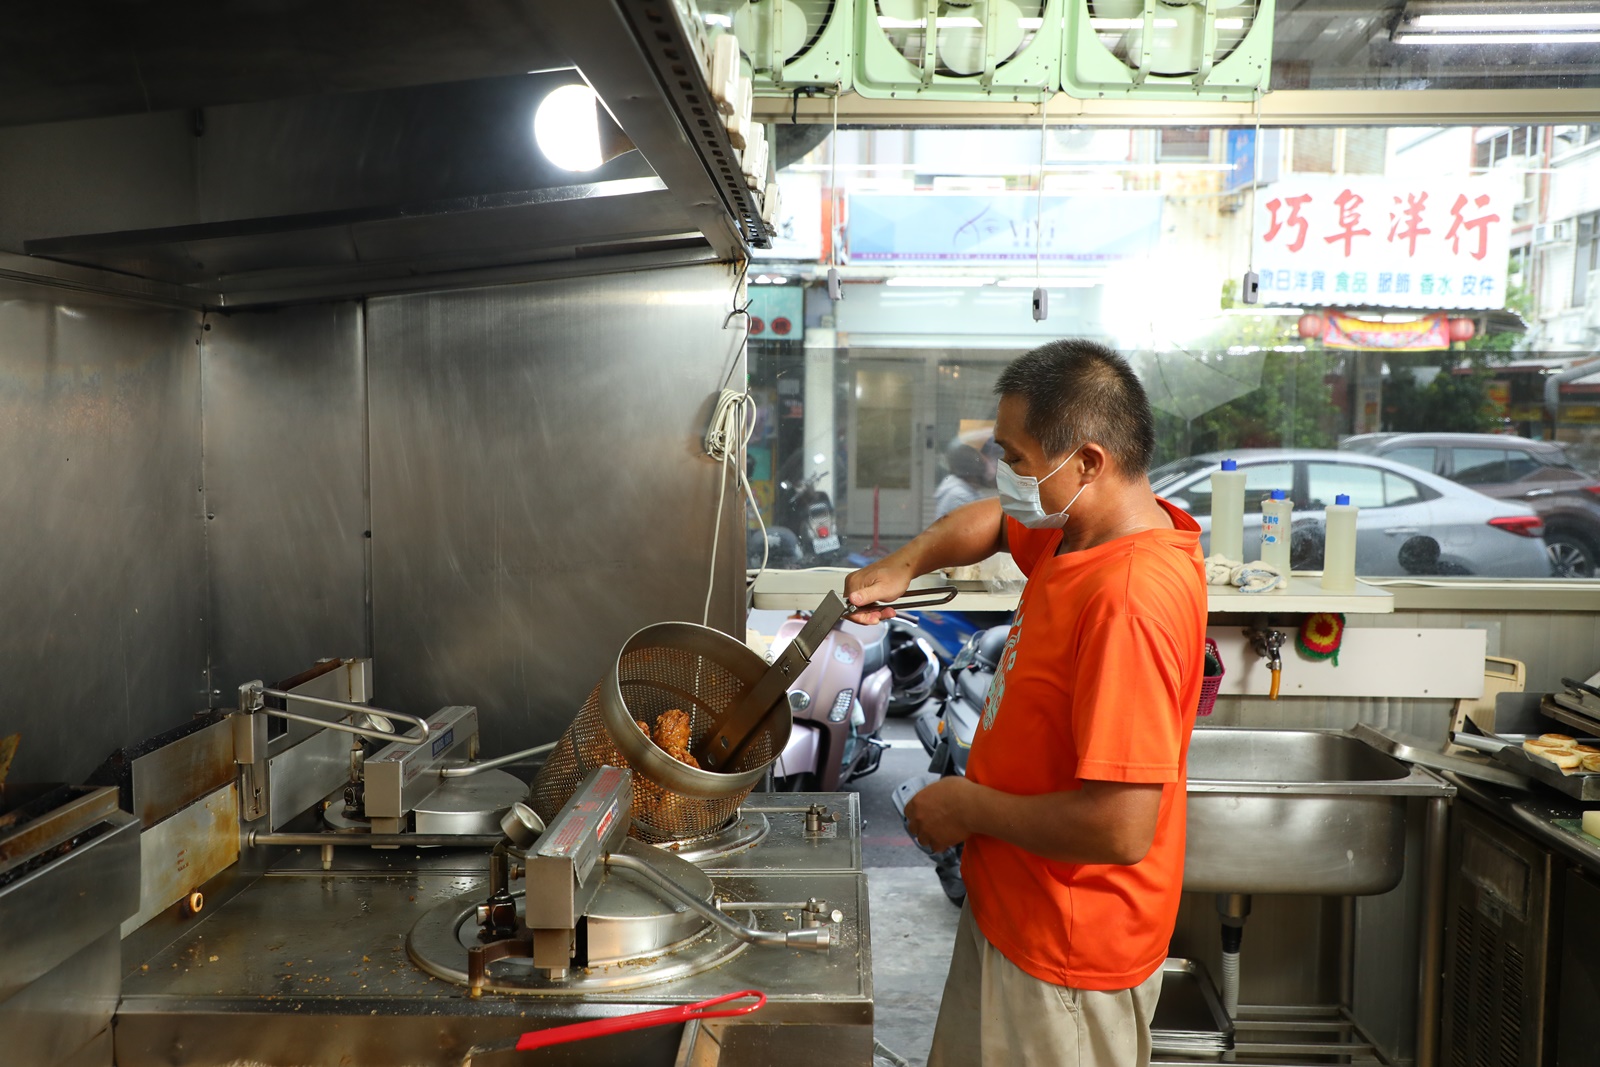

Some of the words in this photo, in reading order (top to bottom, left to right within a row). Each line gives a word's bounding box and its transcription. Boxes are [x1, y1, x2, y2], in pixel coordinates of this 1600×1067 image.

[1262, 188, 1500, 261] 巧阜洋行
[1334, 270, 1368, 294] 食品
[1420, 272, 1453, 295] 香水
[1460, 273, 1496, 296] 皮件
